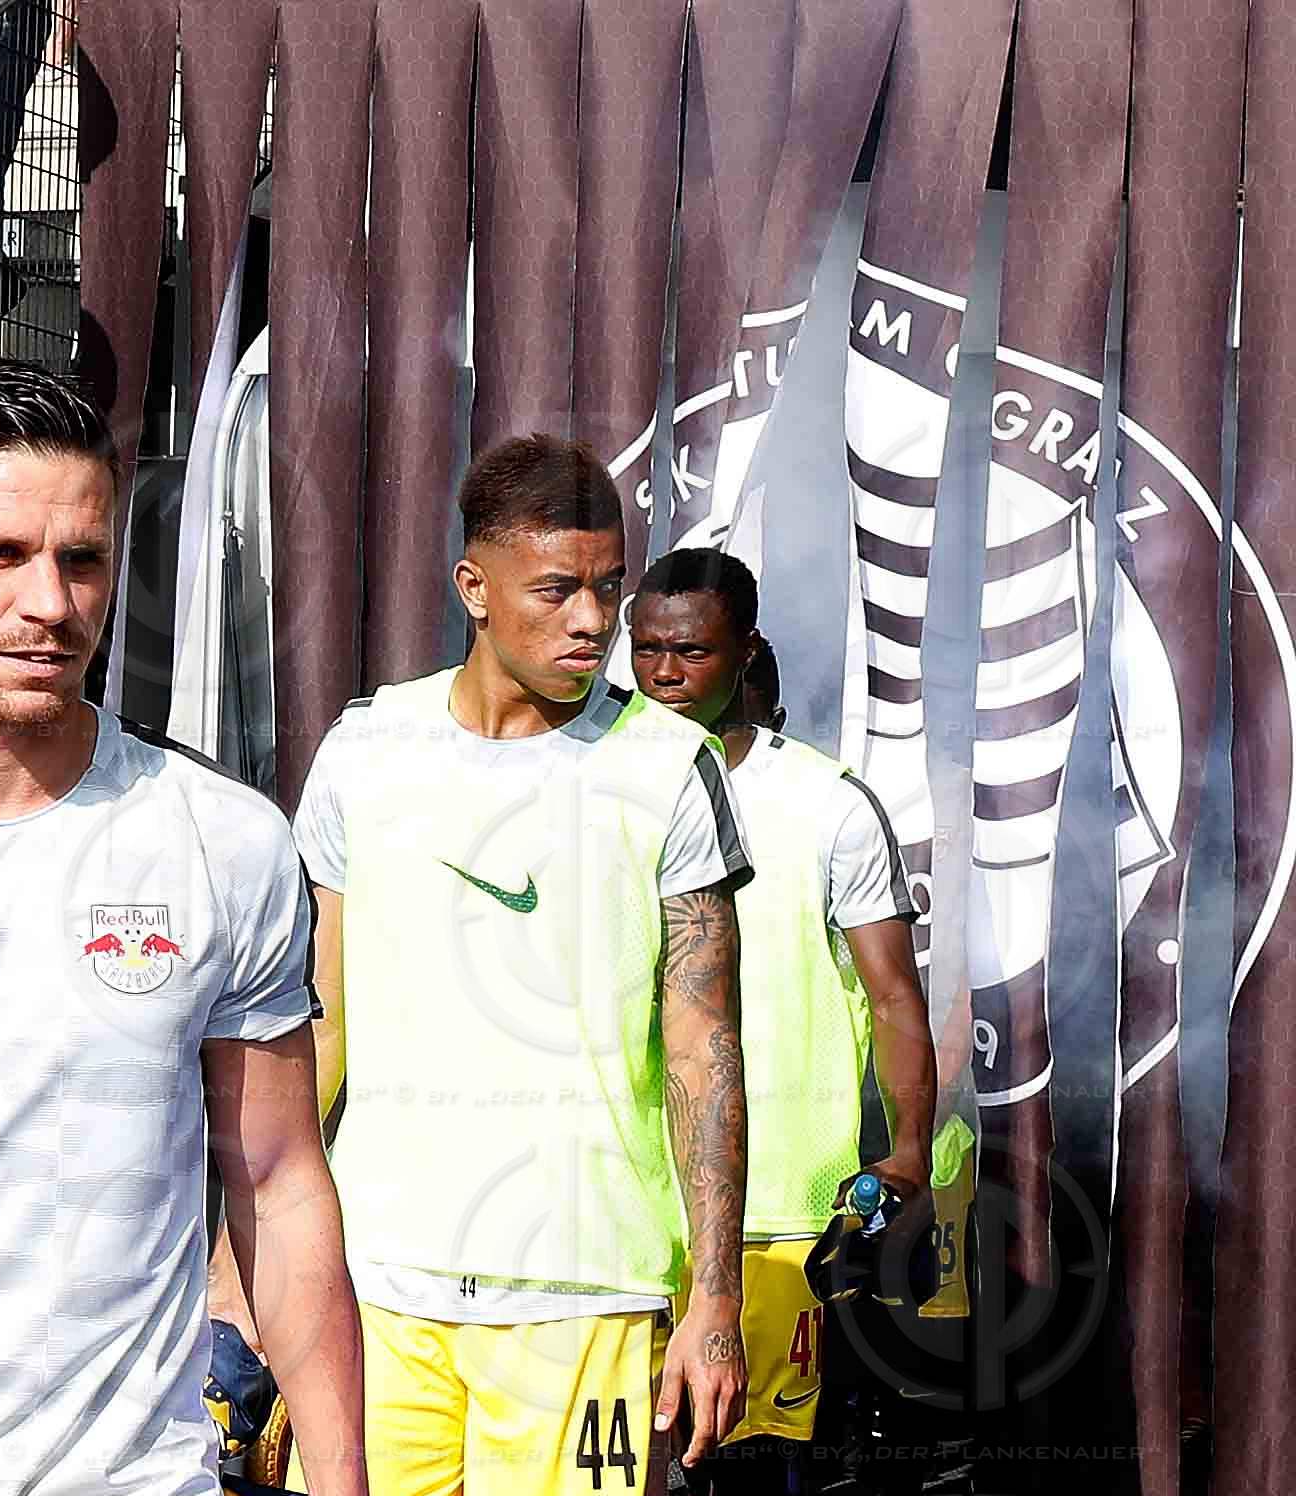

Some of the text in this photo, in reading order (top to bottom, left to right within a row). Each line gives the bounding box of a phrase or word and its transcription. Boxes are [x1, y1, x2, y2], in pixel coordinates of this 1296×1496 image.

[992, 389, 1169, 545] GRAZ
[95, 908, 165, 926] Red Bull
[459, 1275, 476, 1298] 44
[576, 1398, 638, 1490] 44
